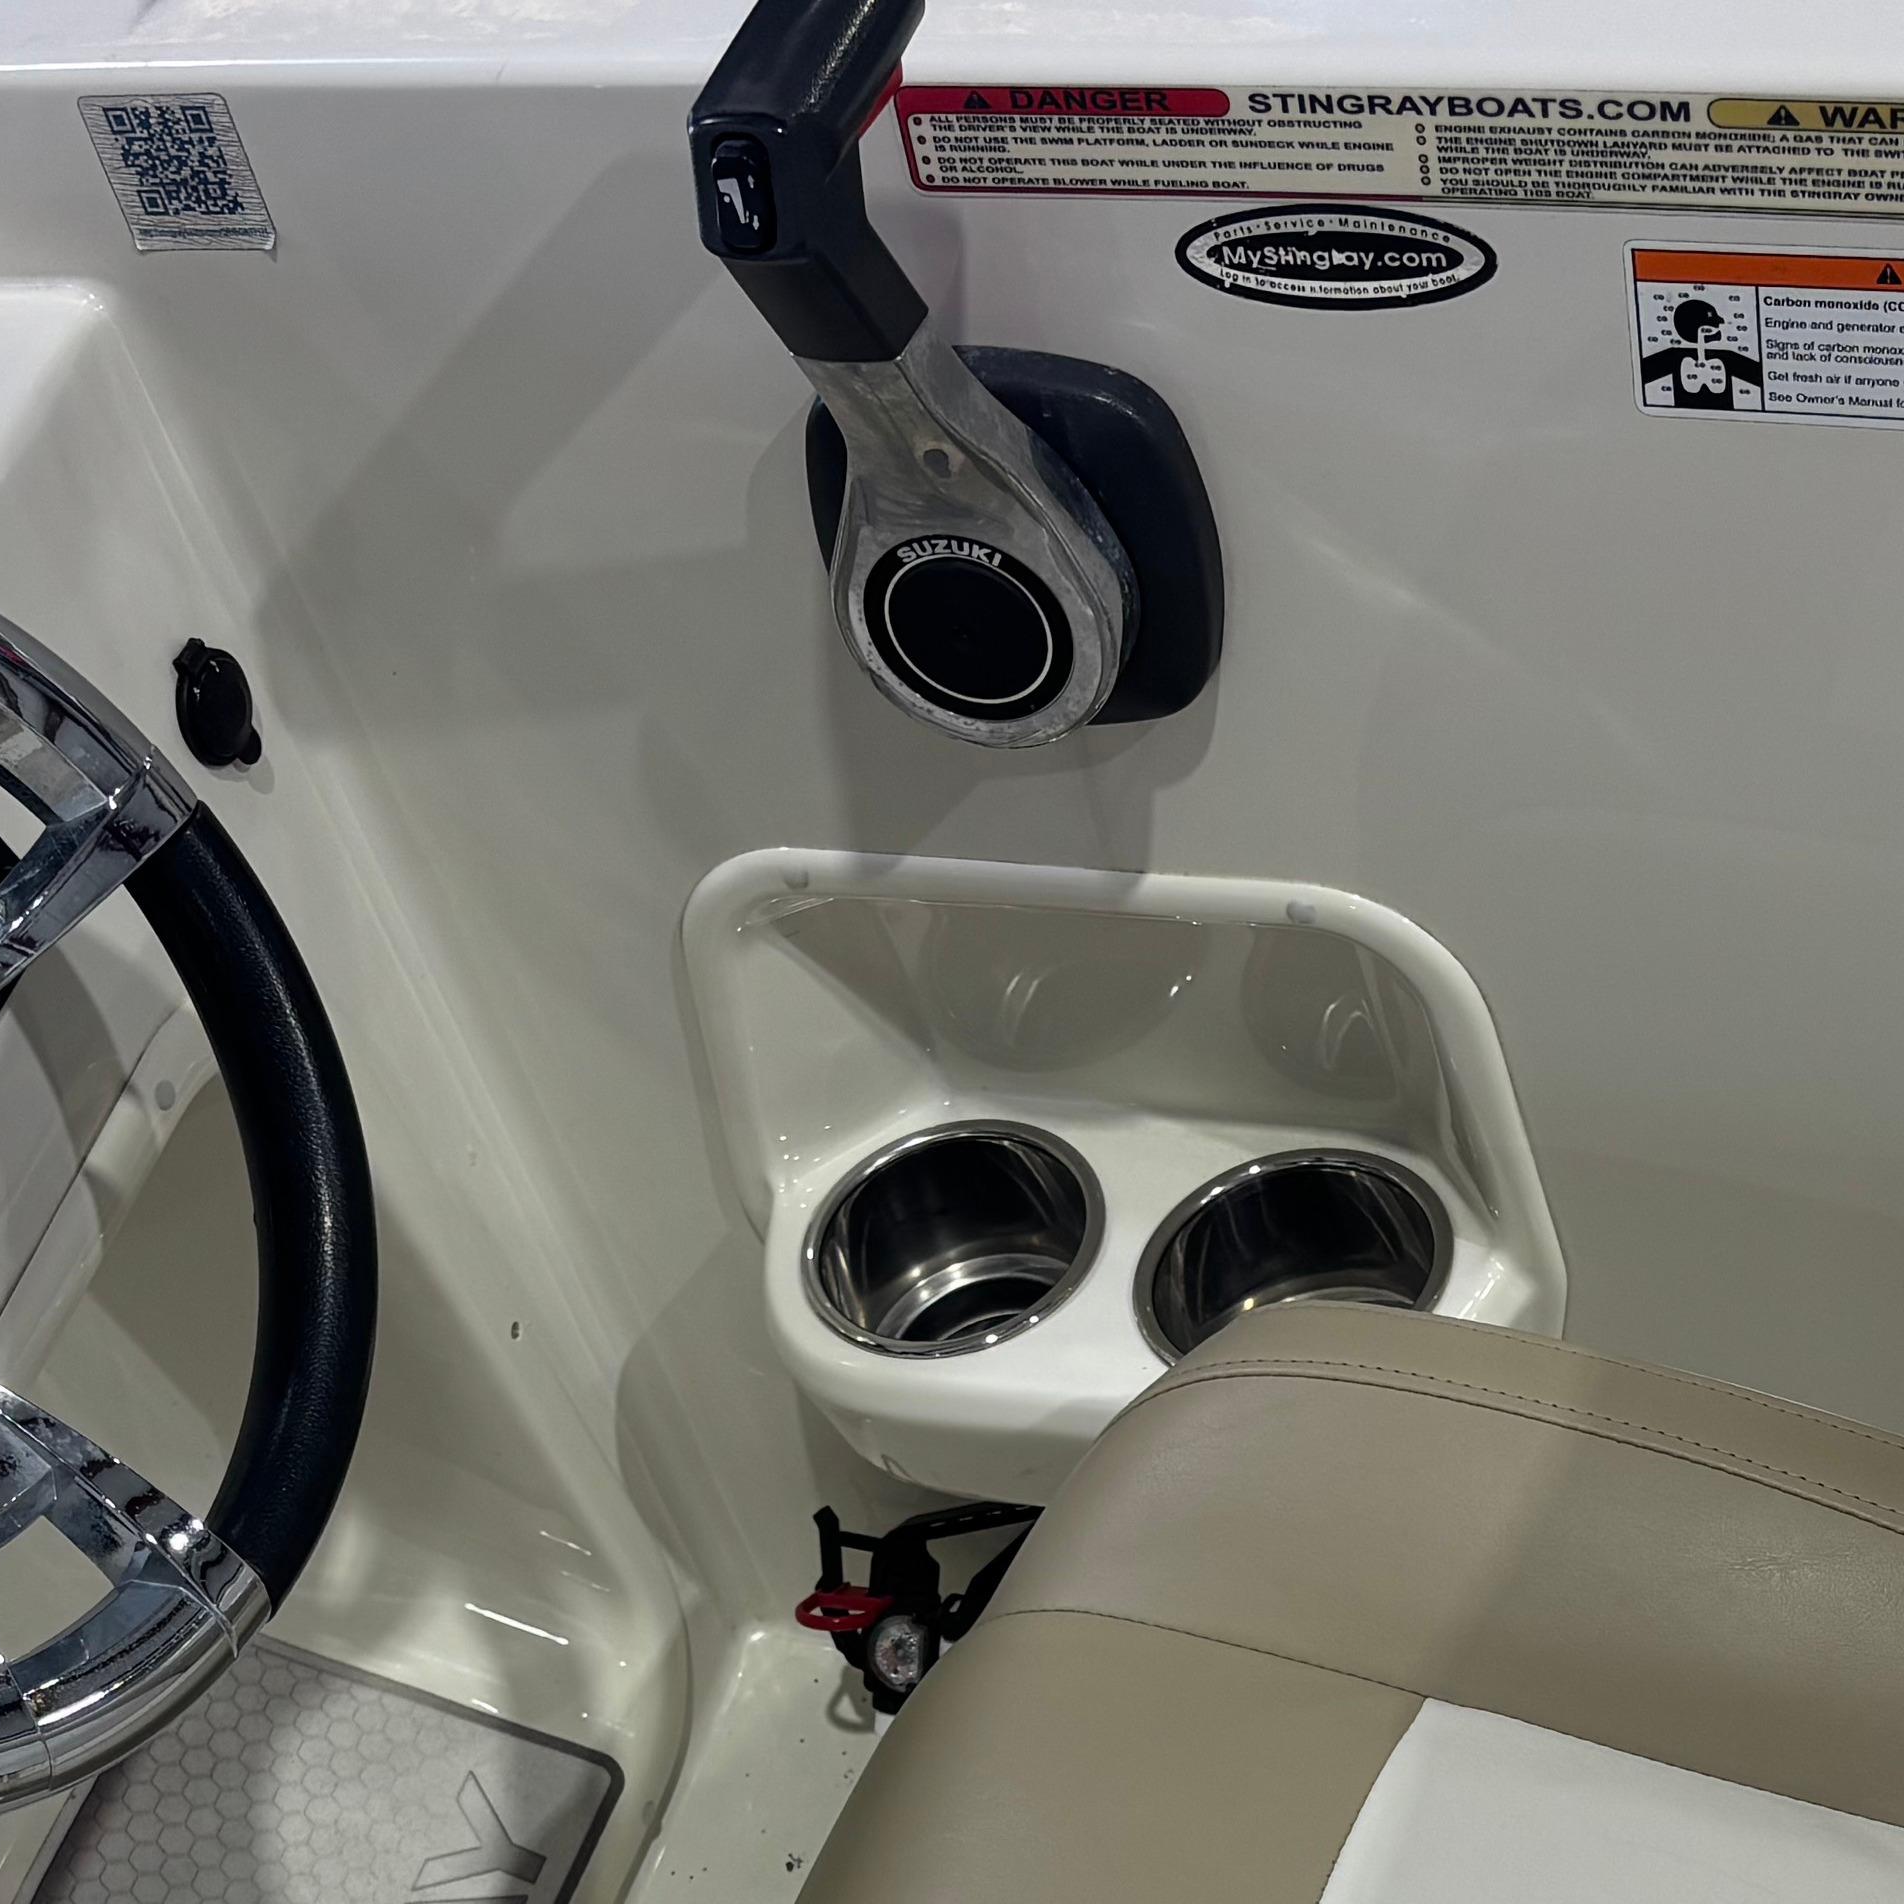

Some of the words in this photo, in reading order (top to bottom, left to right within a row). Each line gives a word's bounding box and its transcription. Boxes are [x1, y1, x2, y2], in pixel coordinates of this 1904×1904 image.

[1010, 89, 1169, 112] DANGER
[1248, 93, 1691, 122] STINGRAYBOATS.COM
[1264, 217, 1325, 231] Service
[1338, 217, 1451, 243] Maintenance
[1764, 297, 1810, 310] Carbon
[1814, 299, 1878, 312] monoxide
[1765, 319, 1806, 332] Engine
[1810, 320, 1832, 331] and
[1837, 321, 1895, 336] generator
[1767, 339, 1799, 353] Signs
[1803, 341, 1814, 351] of
[1818, 341, 1859, 353] carbon
[1767, 350, 1788, 361] and
[1792, 351, 1816, 363] lack
[1820, 352, 1831, 363] of
[1769, 371, 1788, 382] Get
[1793, 371, 1822, 383] fresh
[1826, 373, 1840, 384] air
[1844, 373, 1851, 384] if
[1855, 376, 1899, 388] anyone
[1769, 392, 1792, 403] See
[1848, 395, 1892, 407] Manual
[897, 539, 1002, 567] SUZUKI
